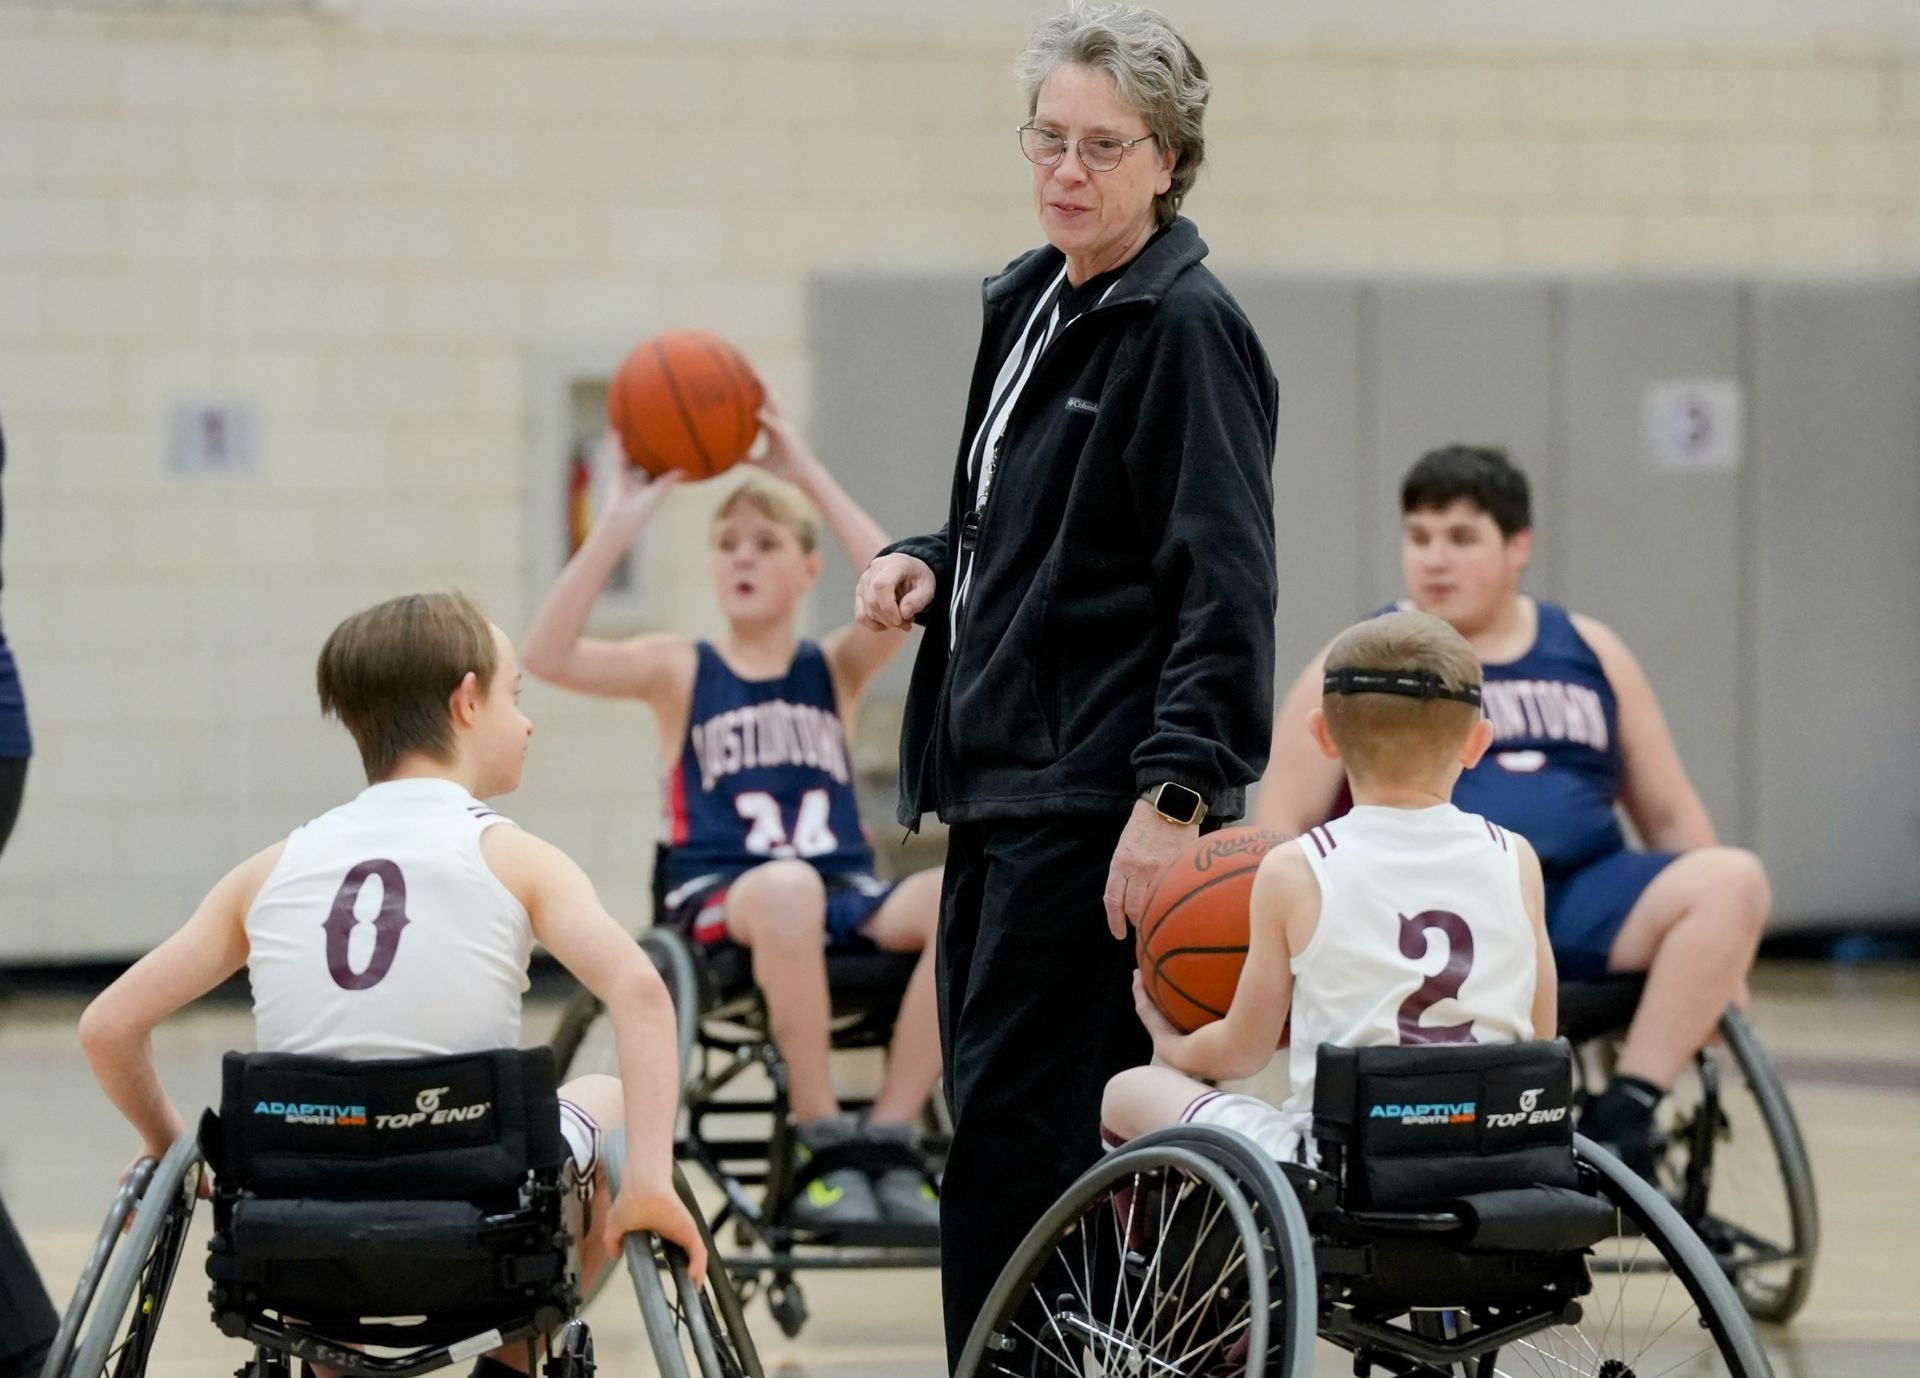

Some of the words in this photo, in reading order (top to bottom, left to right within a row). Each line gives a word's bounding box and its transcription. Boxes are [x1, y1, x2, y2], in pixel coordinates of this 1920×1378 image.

[1073, 400, 1099, 413] Columb
[321, 858, 411, 991] 0
[1397, 909, 1479, 1046] 2
[254, 1101, 366, 1117] ADAPTIVE
[375, 1112, 427, 1130] TOP
[430, 1104, 487, 1123] END
[1369, 1102, 1476, 1118] ADAPTIVE
[1486, 1111, 1522, 1128] TOP
[1528, 1106, 1566, 1123] END
[285, 1114, 335, 1125] SPORTS
[1402, 1114, 1449, 1125] SPORTS
